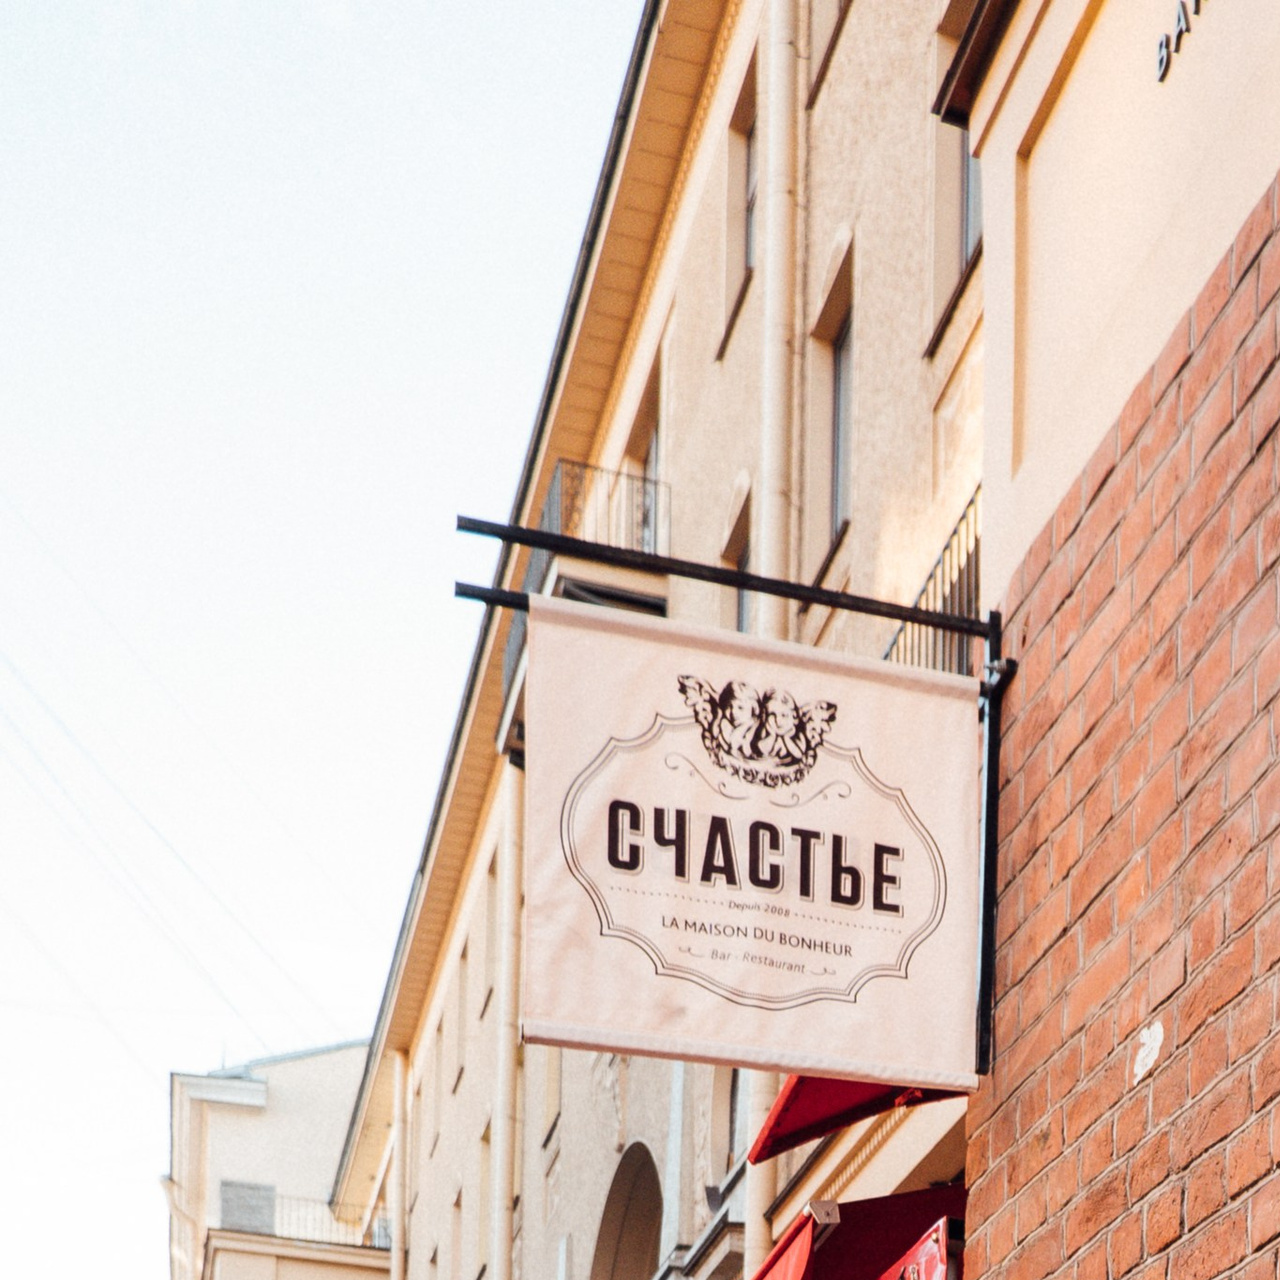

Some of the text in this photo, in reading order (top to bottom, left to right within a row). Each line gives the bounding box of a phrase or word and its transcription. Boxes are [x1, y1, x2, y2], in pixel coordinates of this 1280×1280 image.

[607, 799, 904, 917] СЧАСТЬЕ
[728, 900, 791, 917] Depuis 2008
[661, 915, 853, 957] LA MAISON DU BONHEUR
[710, 949, 806, 974] Bar Restaurant
